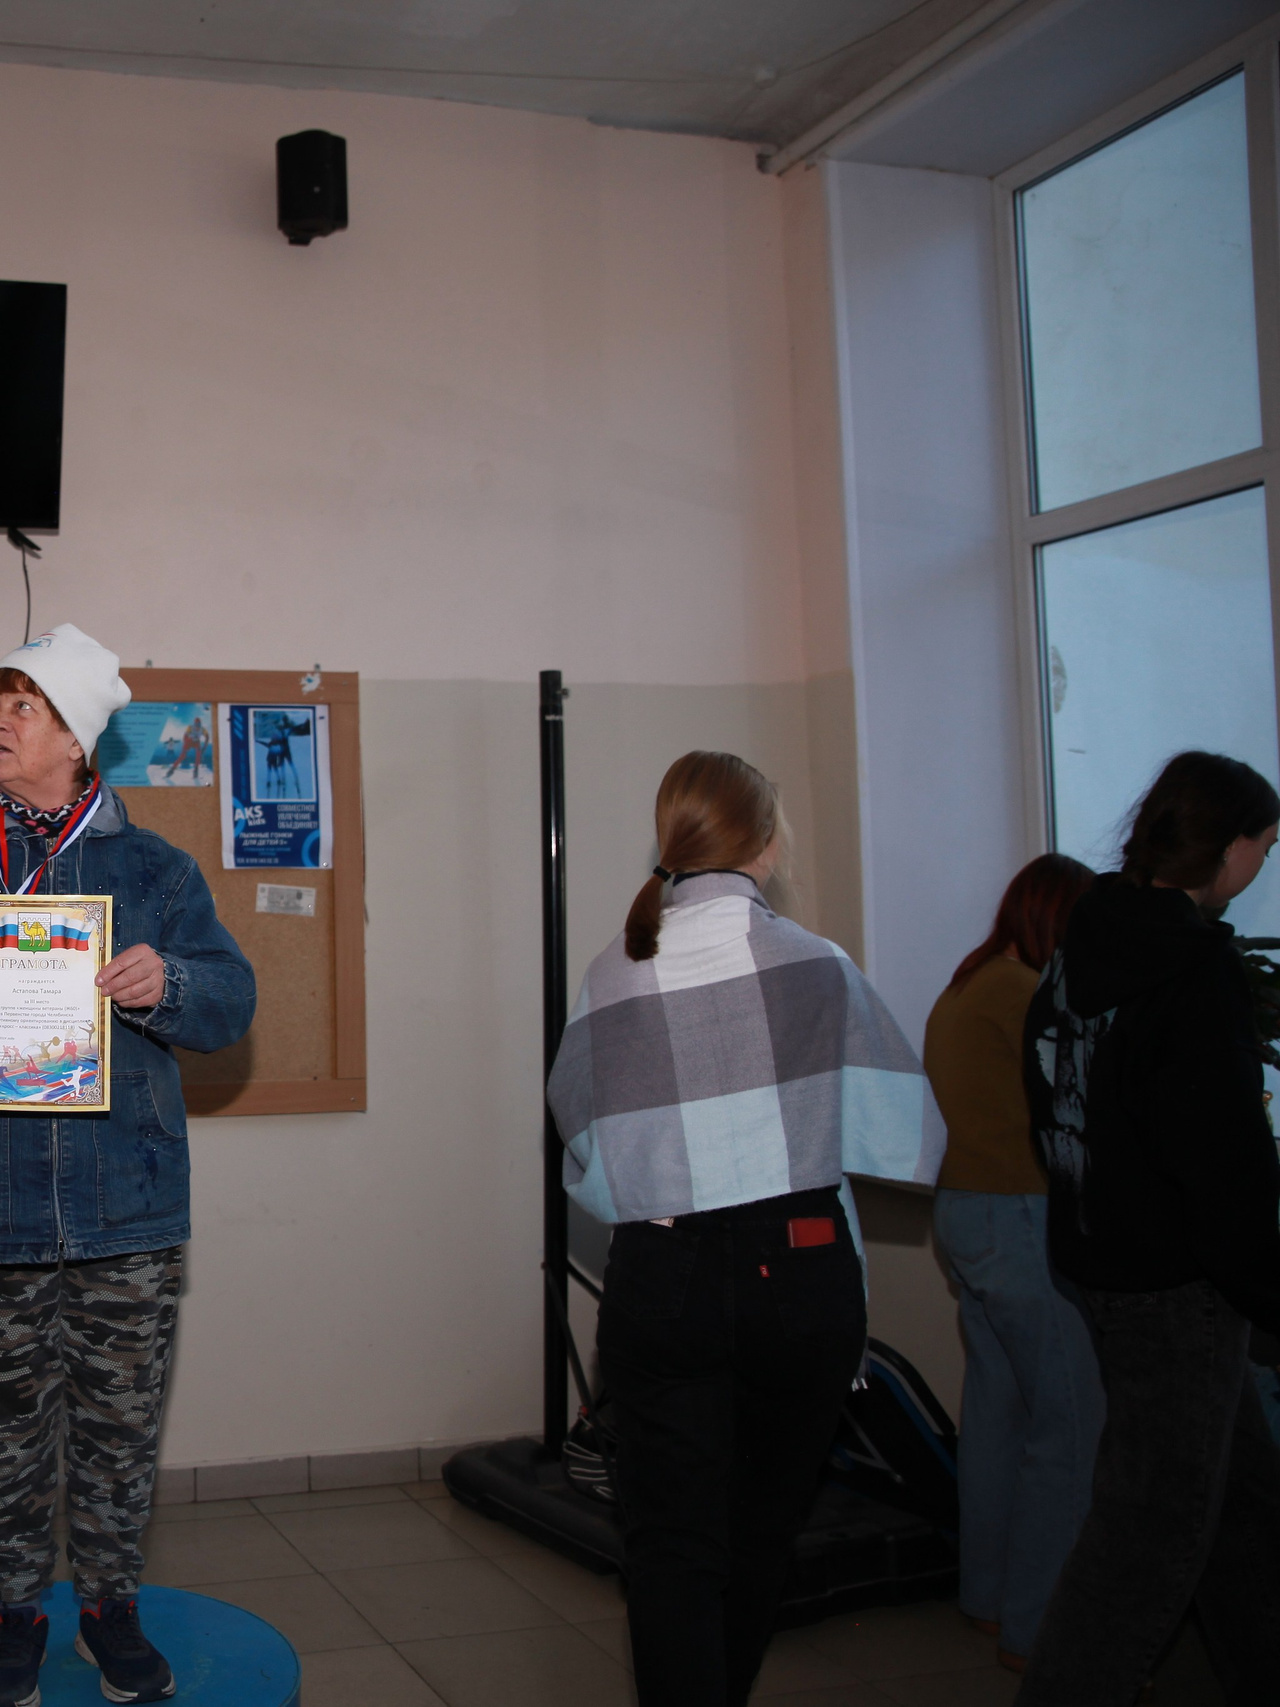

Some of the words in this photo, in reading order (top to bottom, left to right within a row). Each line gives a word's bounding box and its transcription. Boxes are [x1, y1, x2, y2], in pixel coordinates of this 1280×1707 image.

[234, 805, 263, 821] AKS
[247, 818, 266, 827] kids
[0, 958, 69, 970] ГРАМОТА
